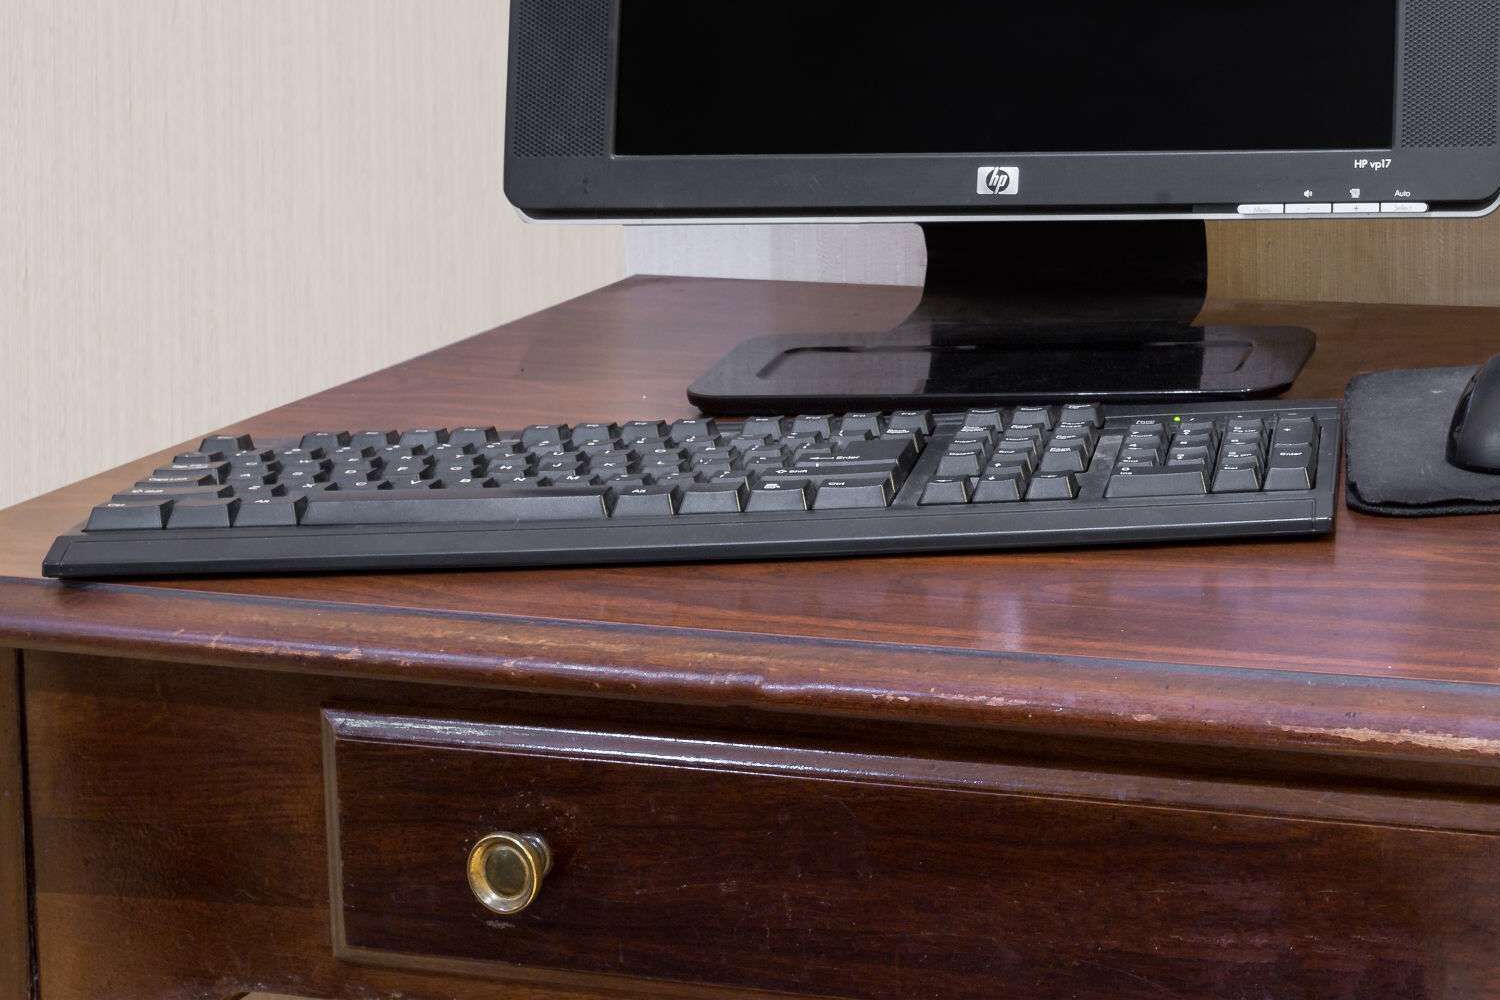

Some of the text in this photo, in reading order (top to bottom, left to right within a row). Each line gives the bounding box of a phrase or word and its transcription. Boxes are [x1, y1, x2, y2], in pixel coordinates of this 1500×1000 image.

[1353, 158, 1392, 171] HP vp17
[986, 167, 1009, 195] hp
[1394, 190, 1411, 198] Auto
